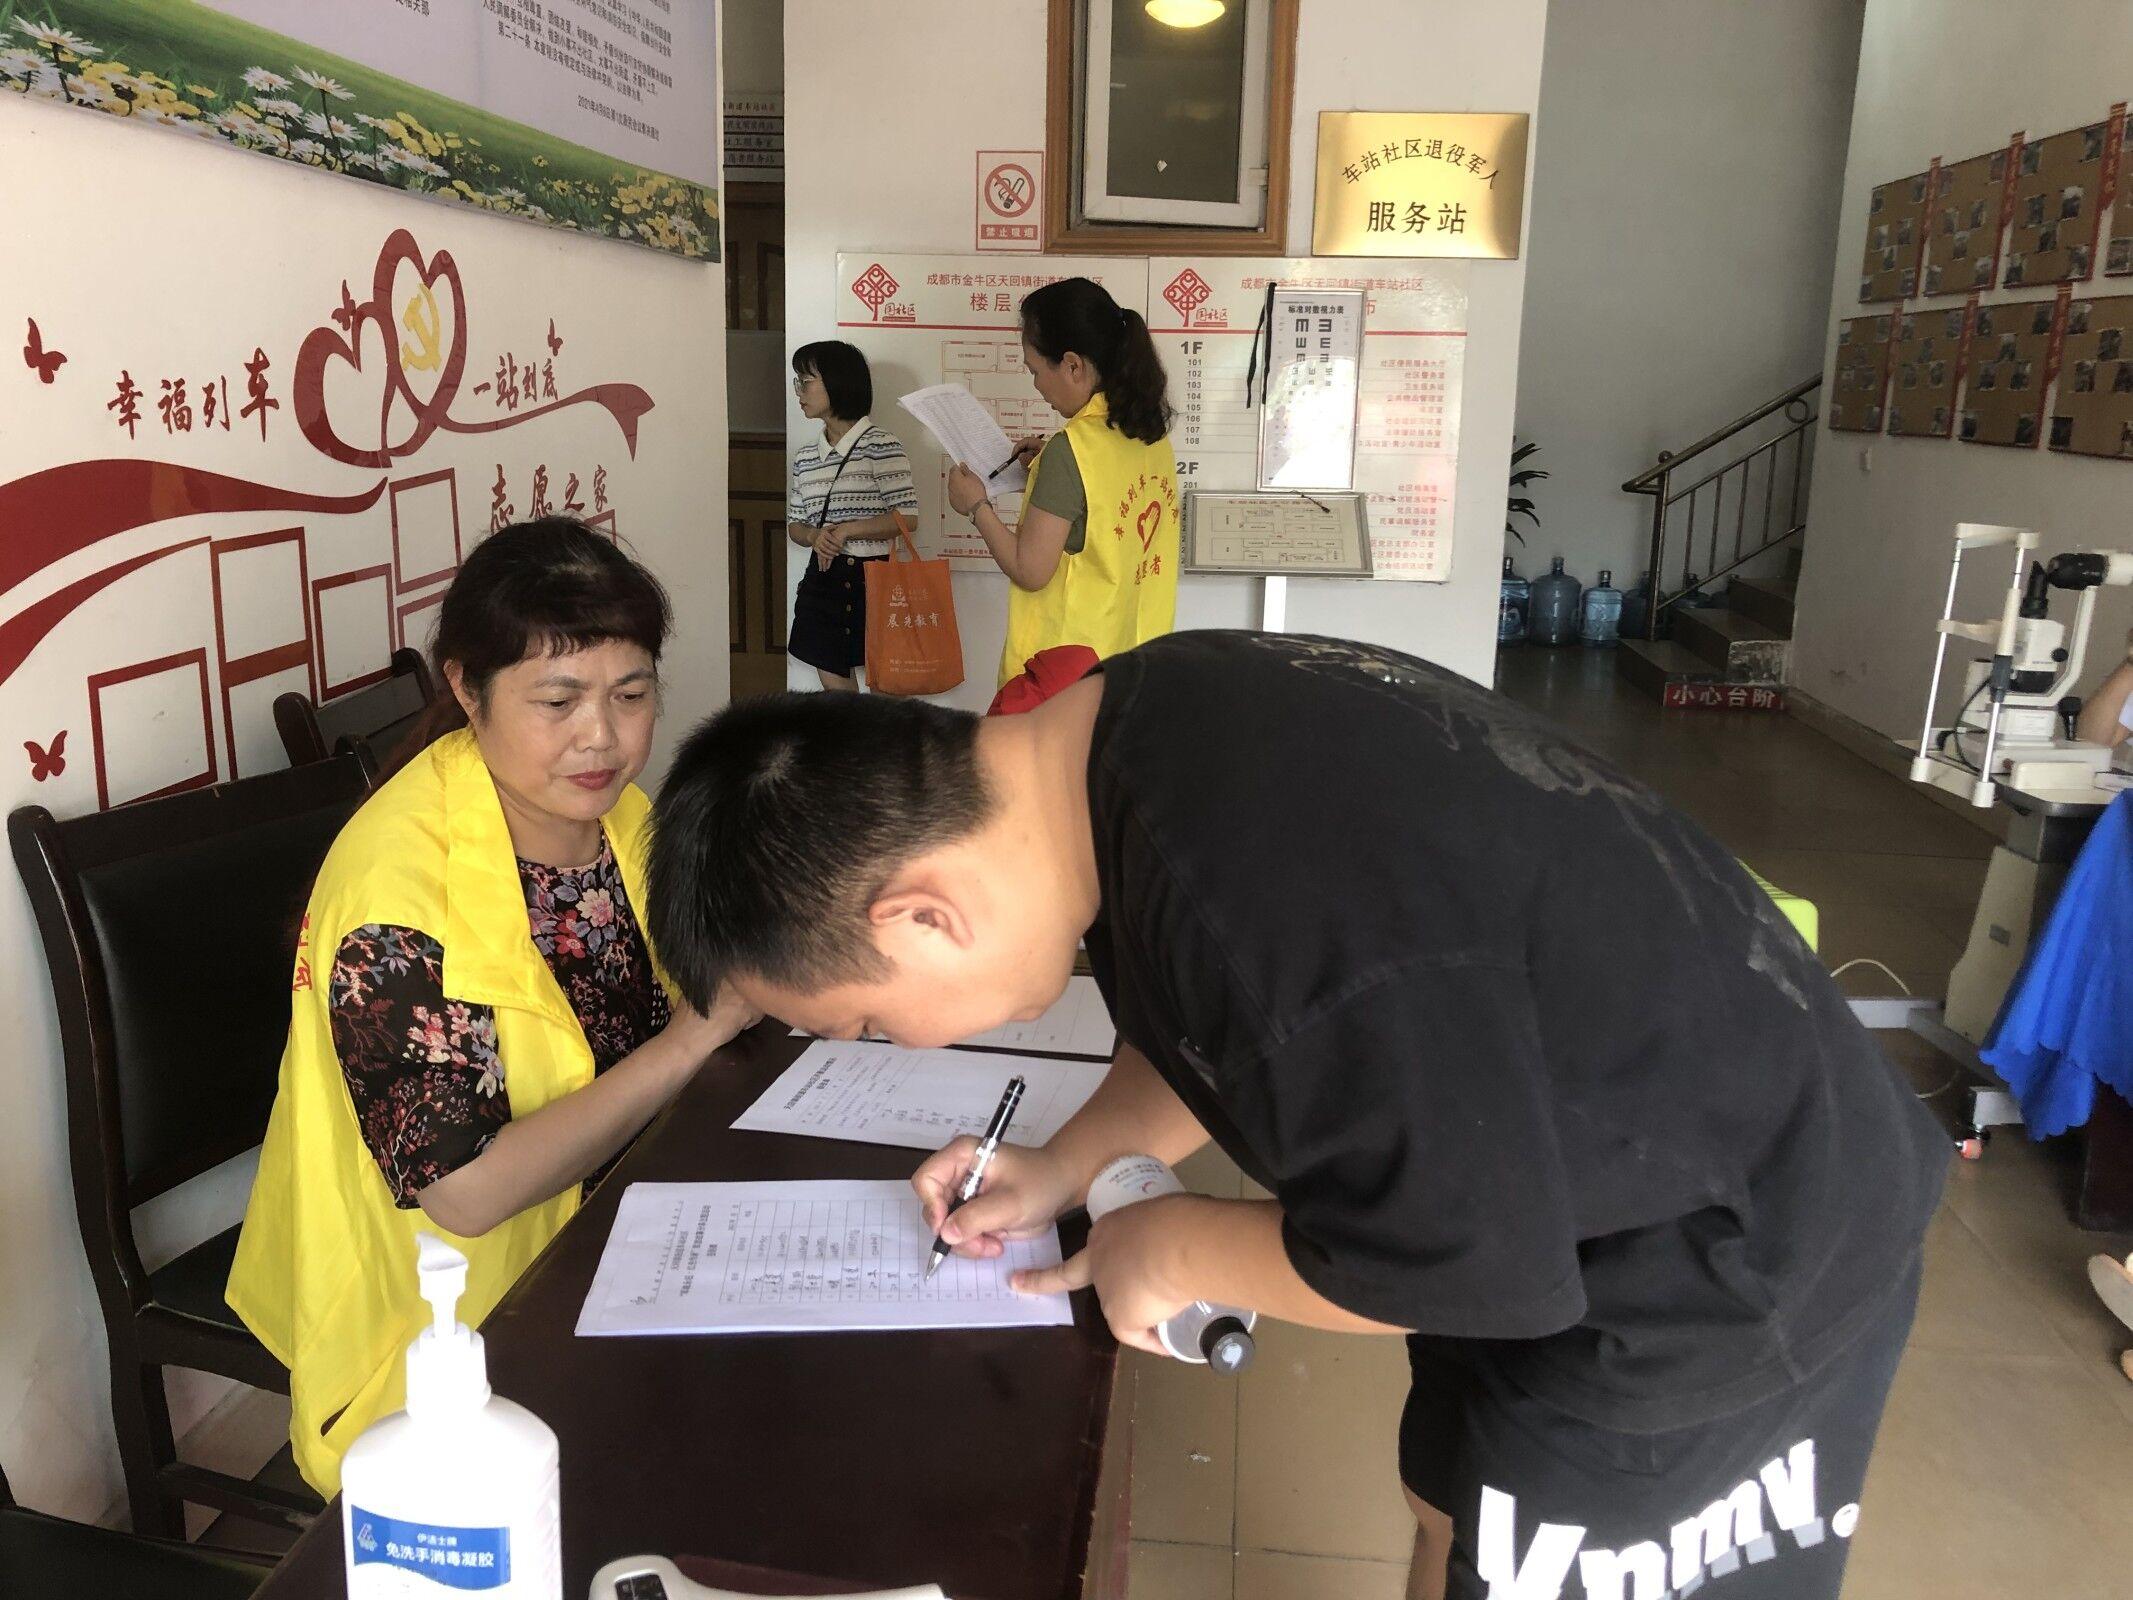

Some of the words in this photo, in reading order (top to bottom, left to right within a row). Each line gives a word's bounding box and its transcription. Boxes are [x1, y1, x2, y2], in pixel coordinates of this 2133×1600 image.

[1342, 138, 1499, 189] 车站社区退役军人
[1366, 201, 1467, 234] 服务站
[985, 226, 1034, 238] 禁止吸烟
[1180, 342, 1203, 355] 1F
[107, 347, 279, 443] 幸福列车
[473, 352, 558, 411] 一站到底
[1176, 462, 1199, 474] 2F
[490, 464, 607, 535] 志愿之家
[1672, 684, 1776, 709] 小心台阶
[386, 1541, 495, 1568] 免洗手消毒凝胶
